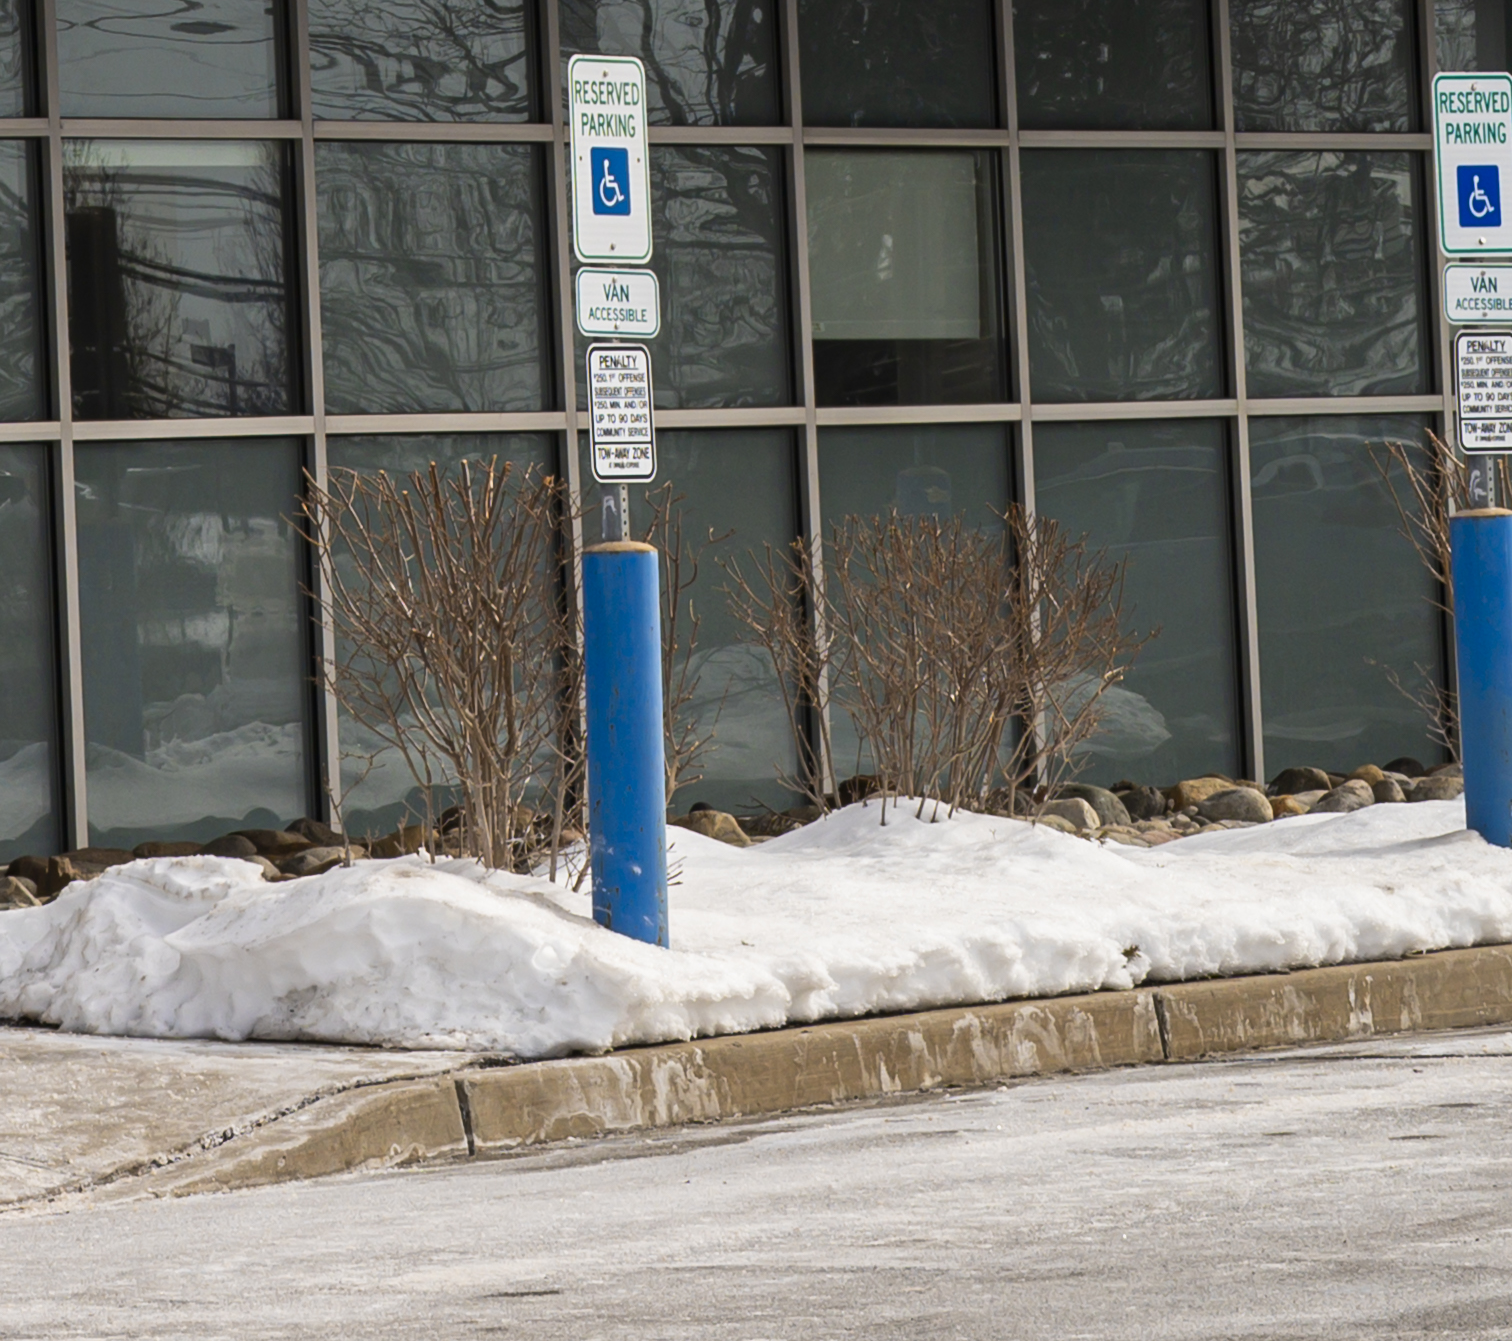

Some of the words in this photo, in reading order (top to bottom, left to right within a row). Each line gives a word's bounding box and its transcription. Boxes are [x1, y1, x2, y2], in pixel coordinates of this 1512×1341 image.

[575, 80, 639, 106] RESERVED
[1439, 91, 1509, 113] RESERVED
[581, 113, 636, 137] PARKING
[1445, 122, 1506, 144] PARKING
[1471, 277, 1497, 294] VAN
[603, 283, 630, 302] VAN
[588, 307, 647, 322] ACCESSIBLE
[1467, 340, 1505, 352] PENALTY
[599, 355, 637, 367] PENALTY
[1486, 355, 1512, 365] OFFENSE
[618, 372, 645, 383] OFFENSE
[1462, 392, 1471, 401] UP
[1474, 392, 1483, 401] TO
[1485, 392, 1495, 401] 90
[596, 414, 605, 423] UP
[607, 414, 616, 423] TO
[618, 413, 628, 423] 90
[630, 413, 648, 423] DAYS
[597, 427, 625, 437] COMMUNITY
[628, 427, 648, 437] SERVICE
[598, 447, 630, 460] TOW-AWAY
[633, 447, 649, 459] ZONE
